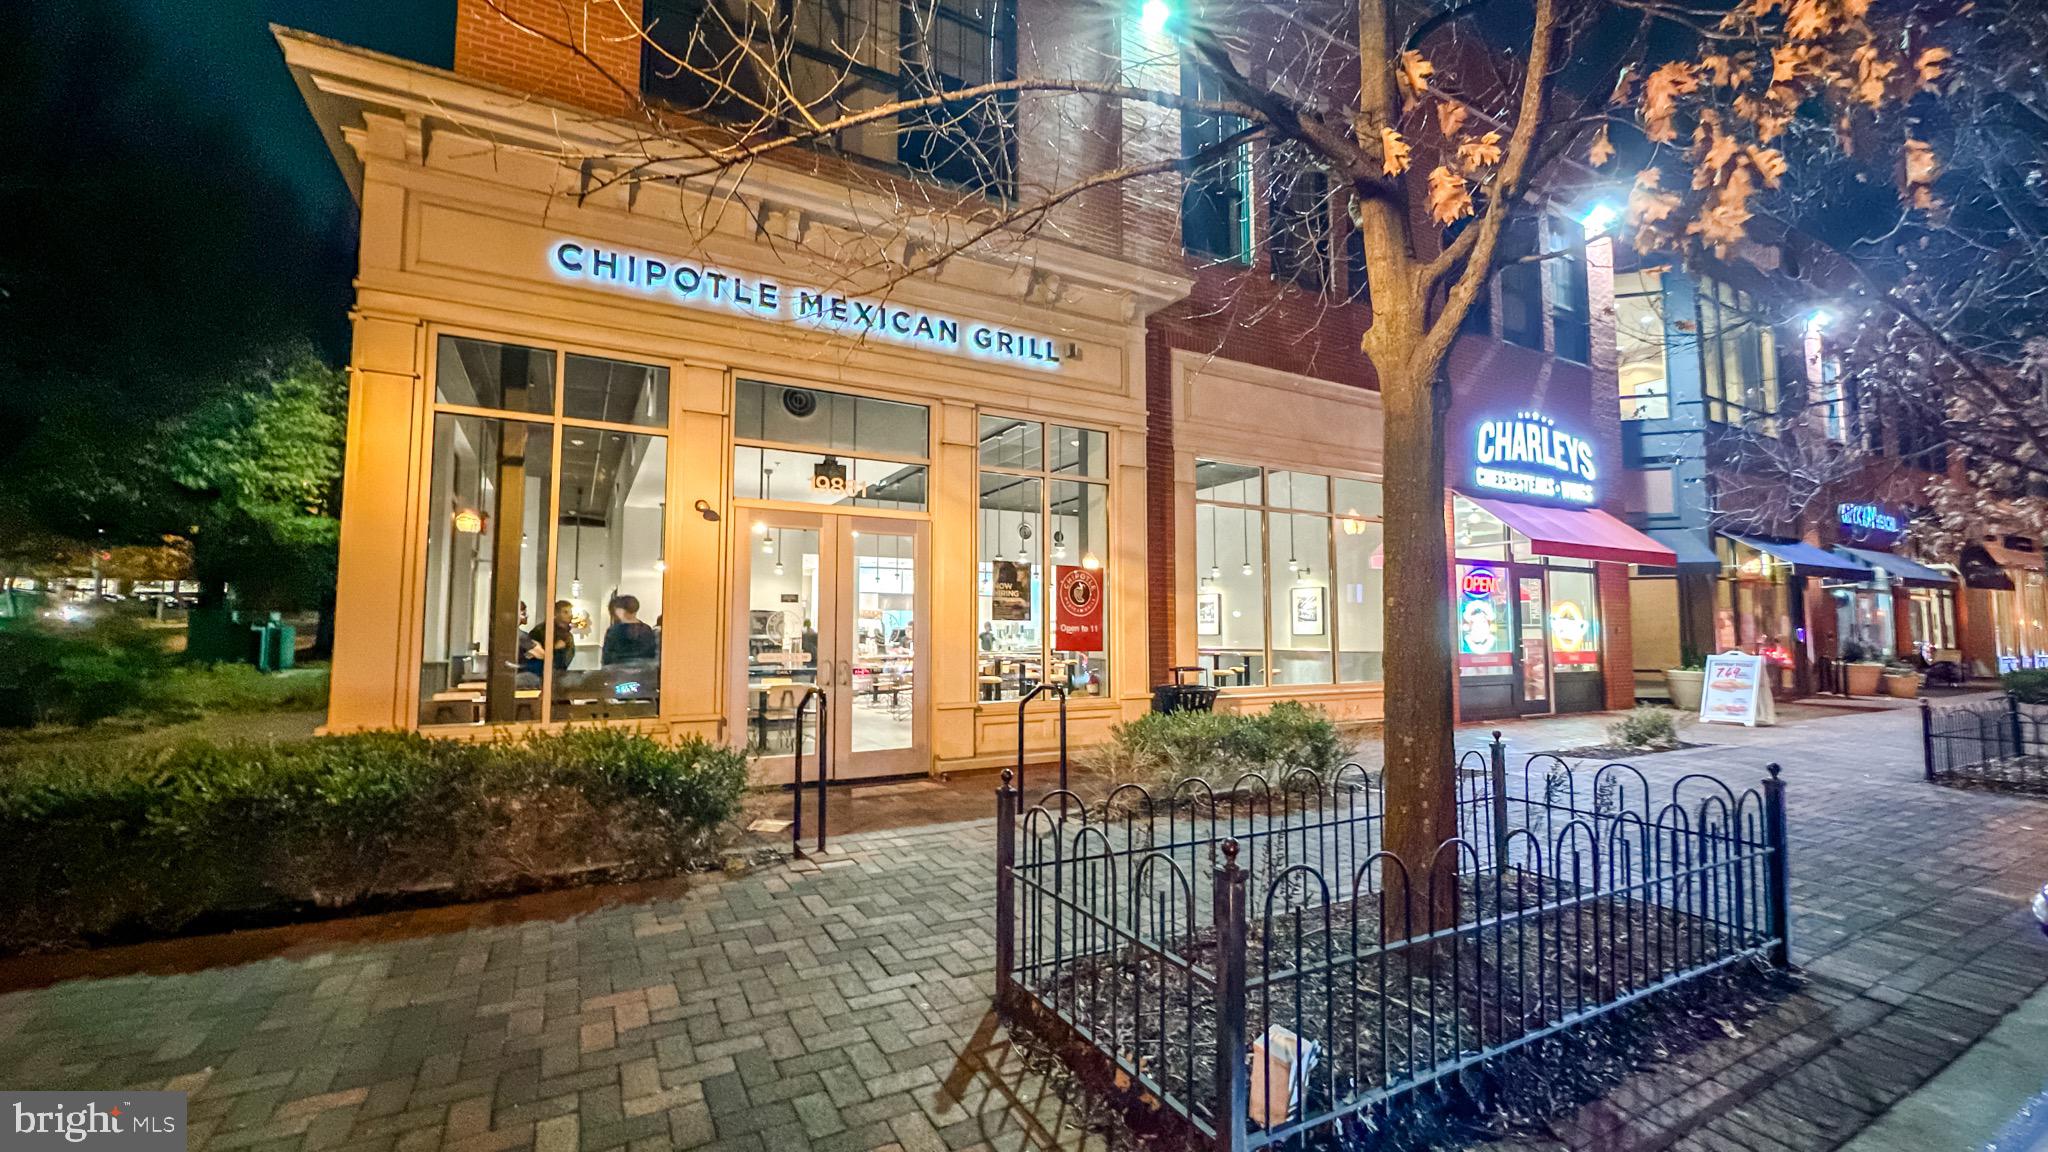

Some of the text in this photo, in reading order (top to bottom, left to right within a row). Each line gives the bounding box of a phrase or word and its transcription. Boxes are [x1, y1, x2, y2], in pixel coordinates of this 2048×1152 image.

[557, 243, 1061, 364] CHIPOTLE MEXICAN GRILL
[1477, 421, 1597, 481] CHARLEYS
[1063, 573, 1097, 592] CHIPOTLE
[1463, 575, 1496, 593] OPEN
[1060, 624, 1098, 634] Open to 11
